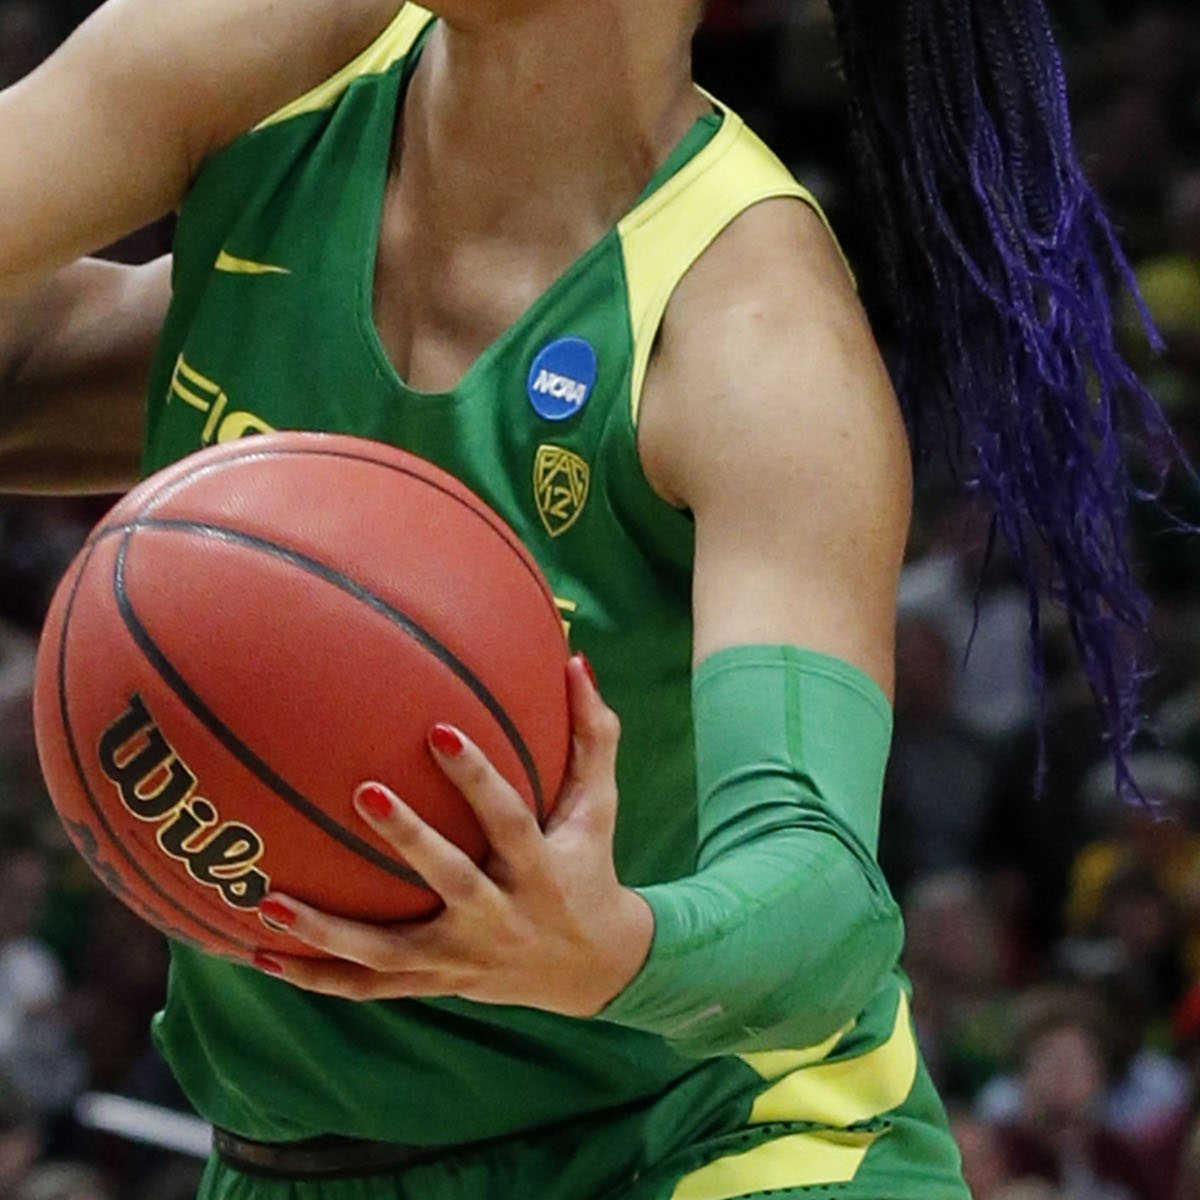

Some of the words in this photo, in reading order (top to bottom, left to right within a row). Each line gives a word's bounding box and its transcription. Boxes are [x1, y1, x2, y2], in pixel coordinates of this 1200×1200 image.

[532, 368, 588, 407] NCAA
[542, 485, 573, 520] 12
[98, 689, 289, 932] Wils
